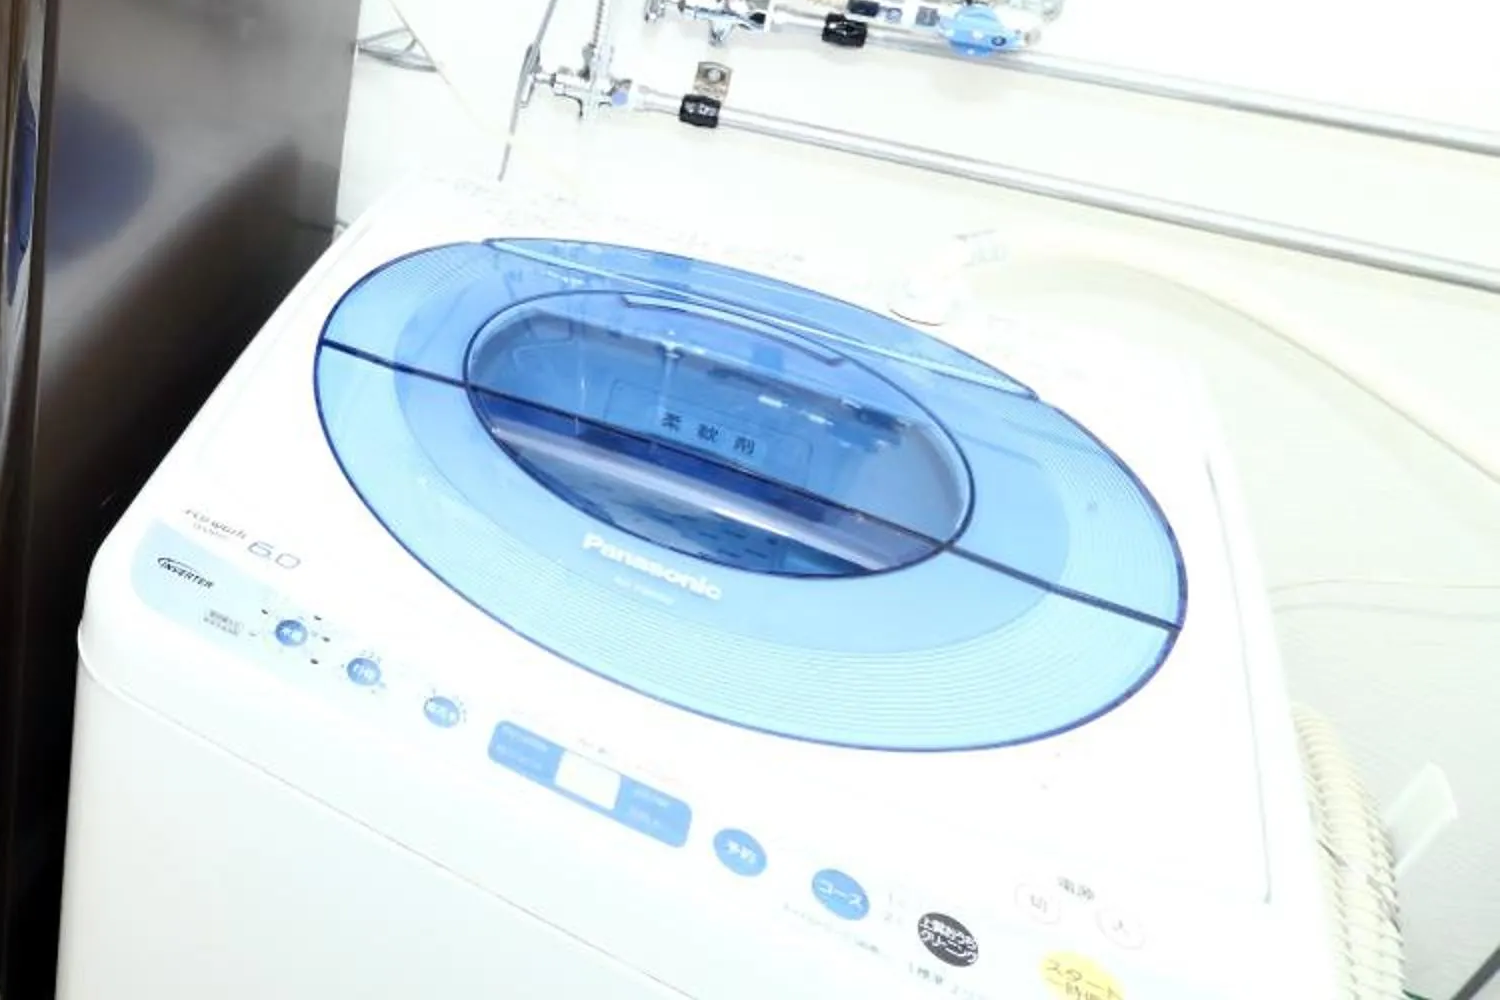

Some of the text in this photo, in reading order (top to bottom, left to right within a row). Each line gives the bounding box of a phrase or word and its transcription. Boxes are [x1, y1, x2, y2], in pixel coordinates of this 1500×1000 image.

[660, 411, 756, 456] 柔軟剤
[159, 560, 214, 588] INVERTER
[581, 531, 723, 601] Panasonic
[818, 879, 864, 909] コース
